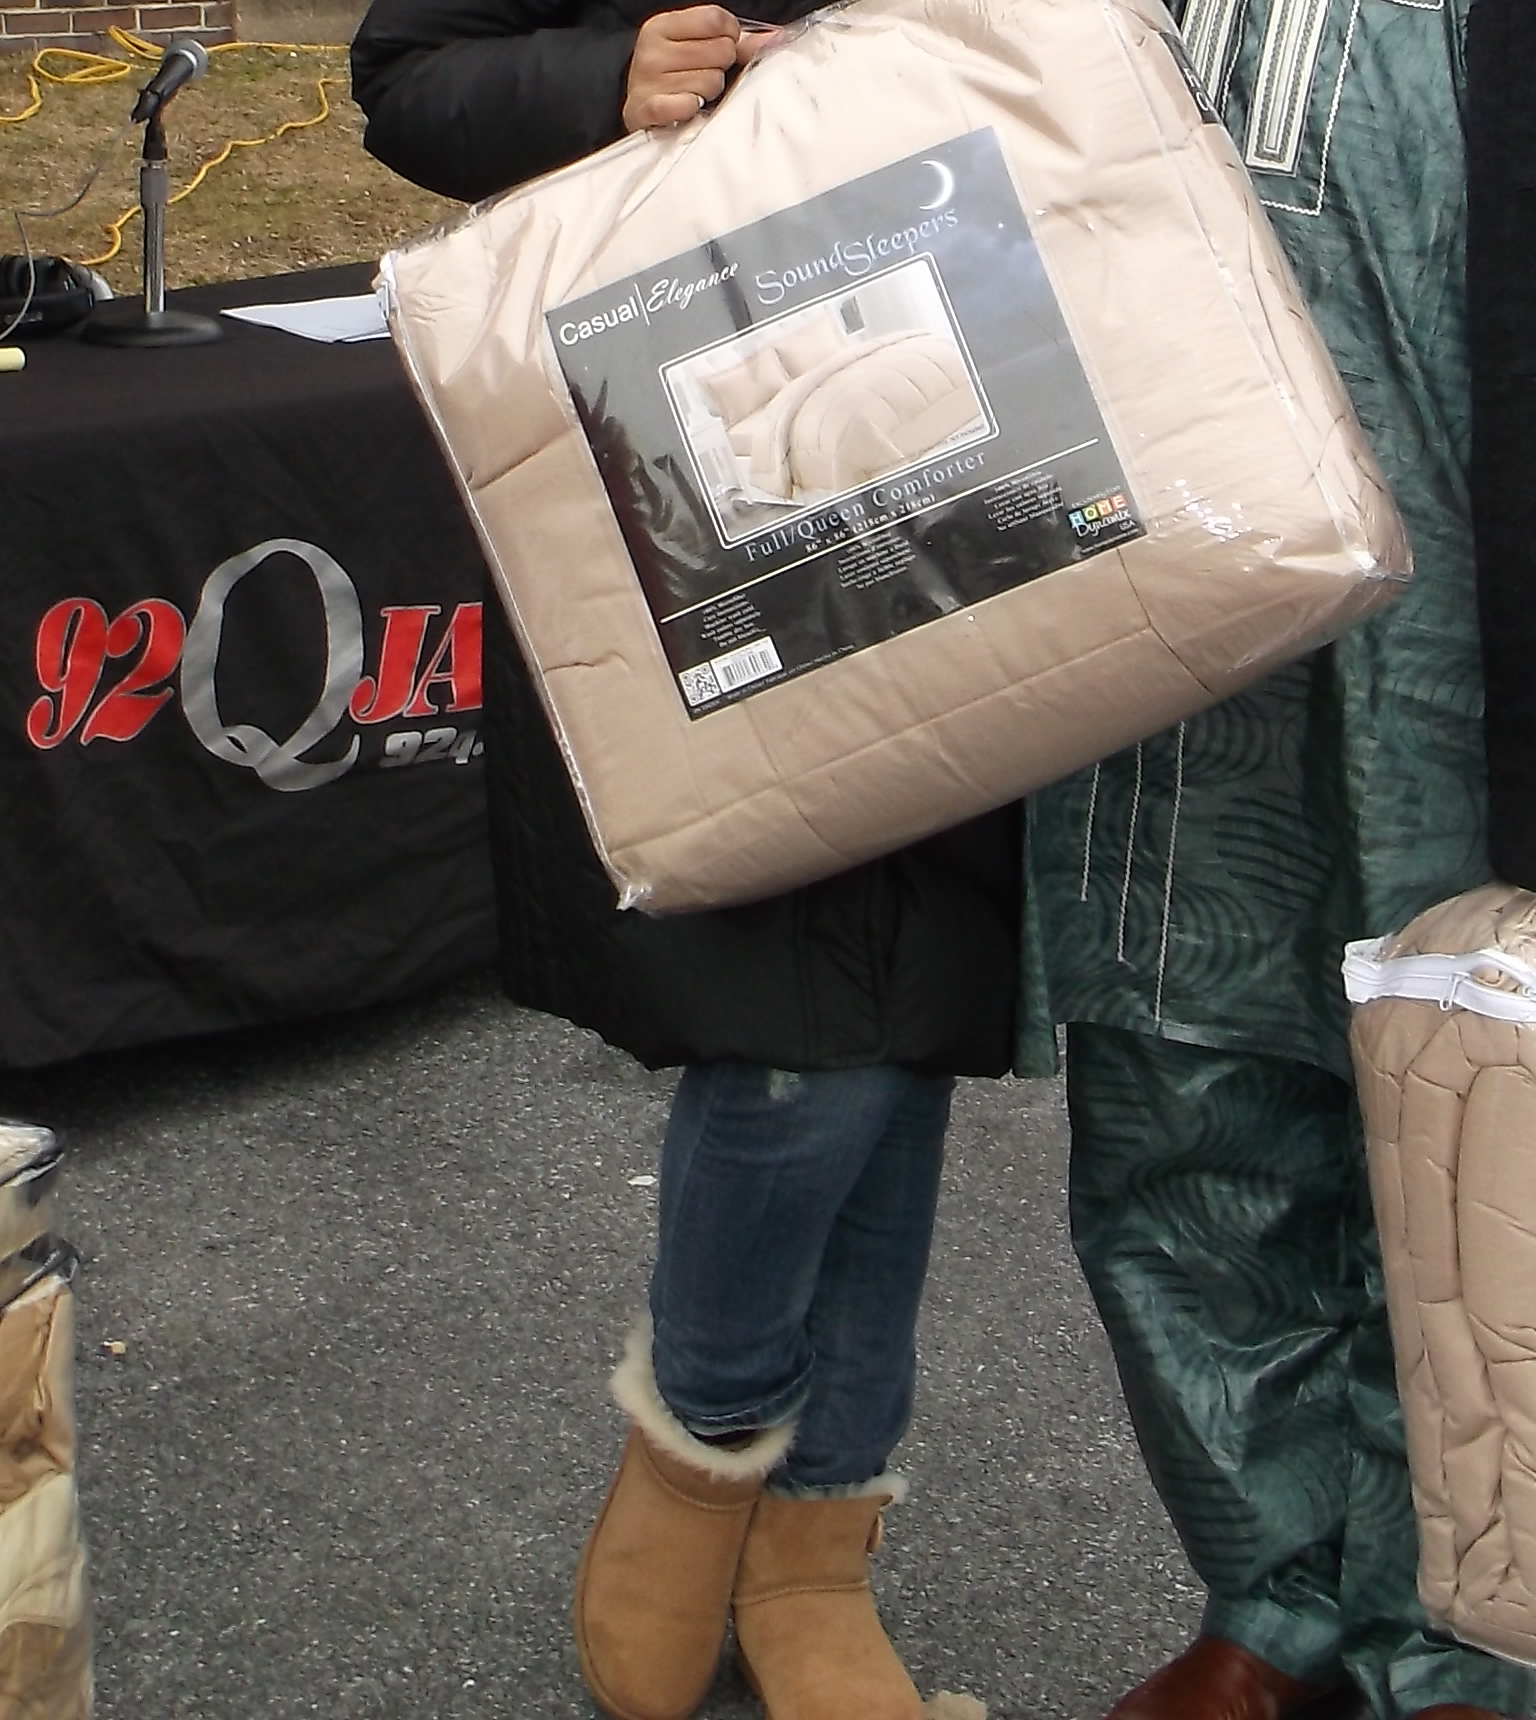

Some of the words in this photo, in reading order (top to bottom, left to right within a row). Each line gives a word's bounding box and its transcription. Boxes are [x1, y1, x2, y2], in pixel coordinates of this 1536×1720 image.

[559, 295, 640, 346] Casual
[646, 262, 739, 314] Elegance
[744, 502, 866, 563] Full/Queen
[871, 450, 987, 508] Comforter
